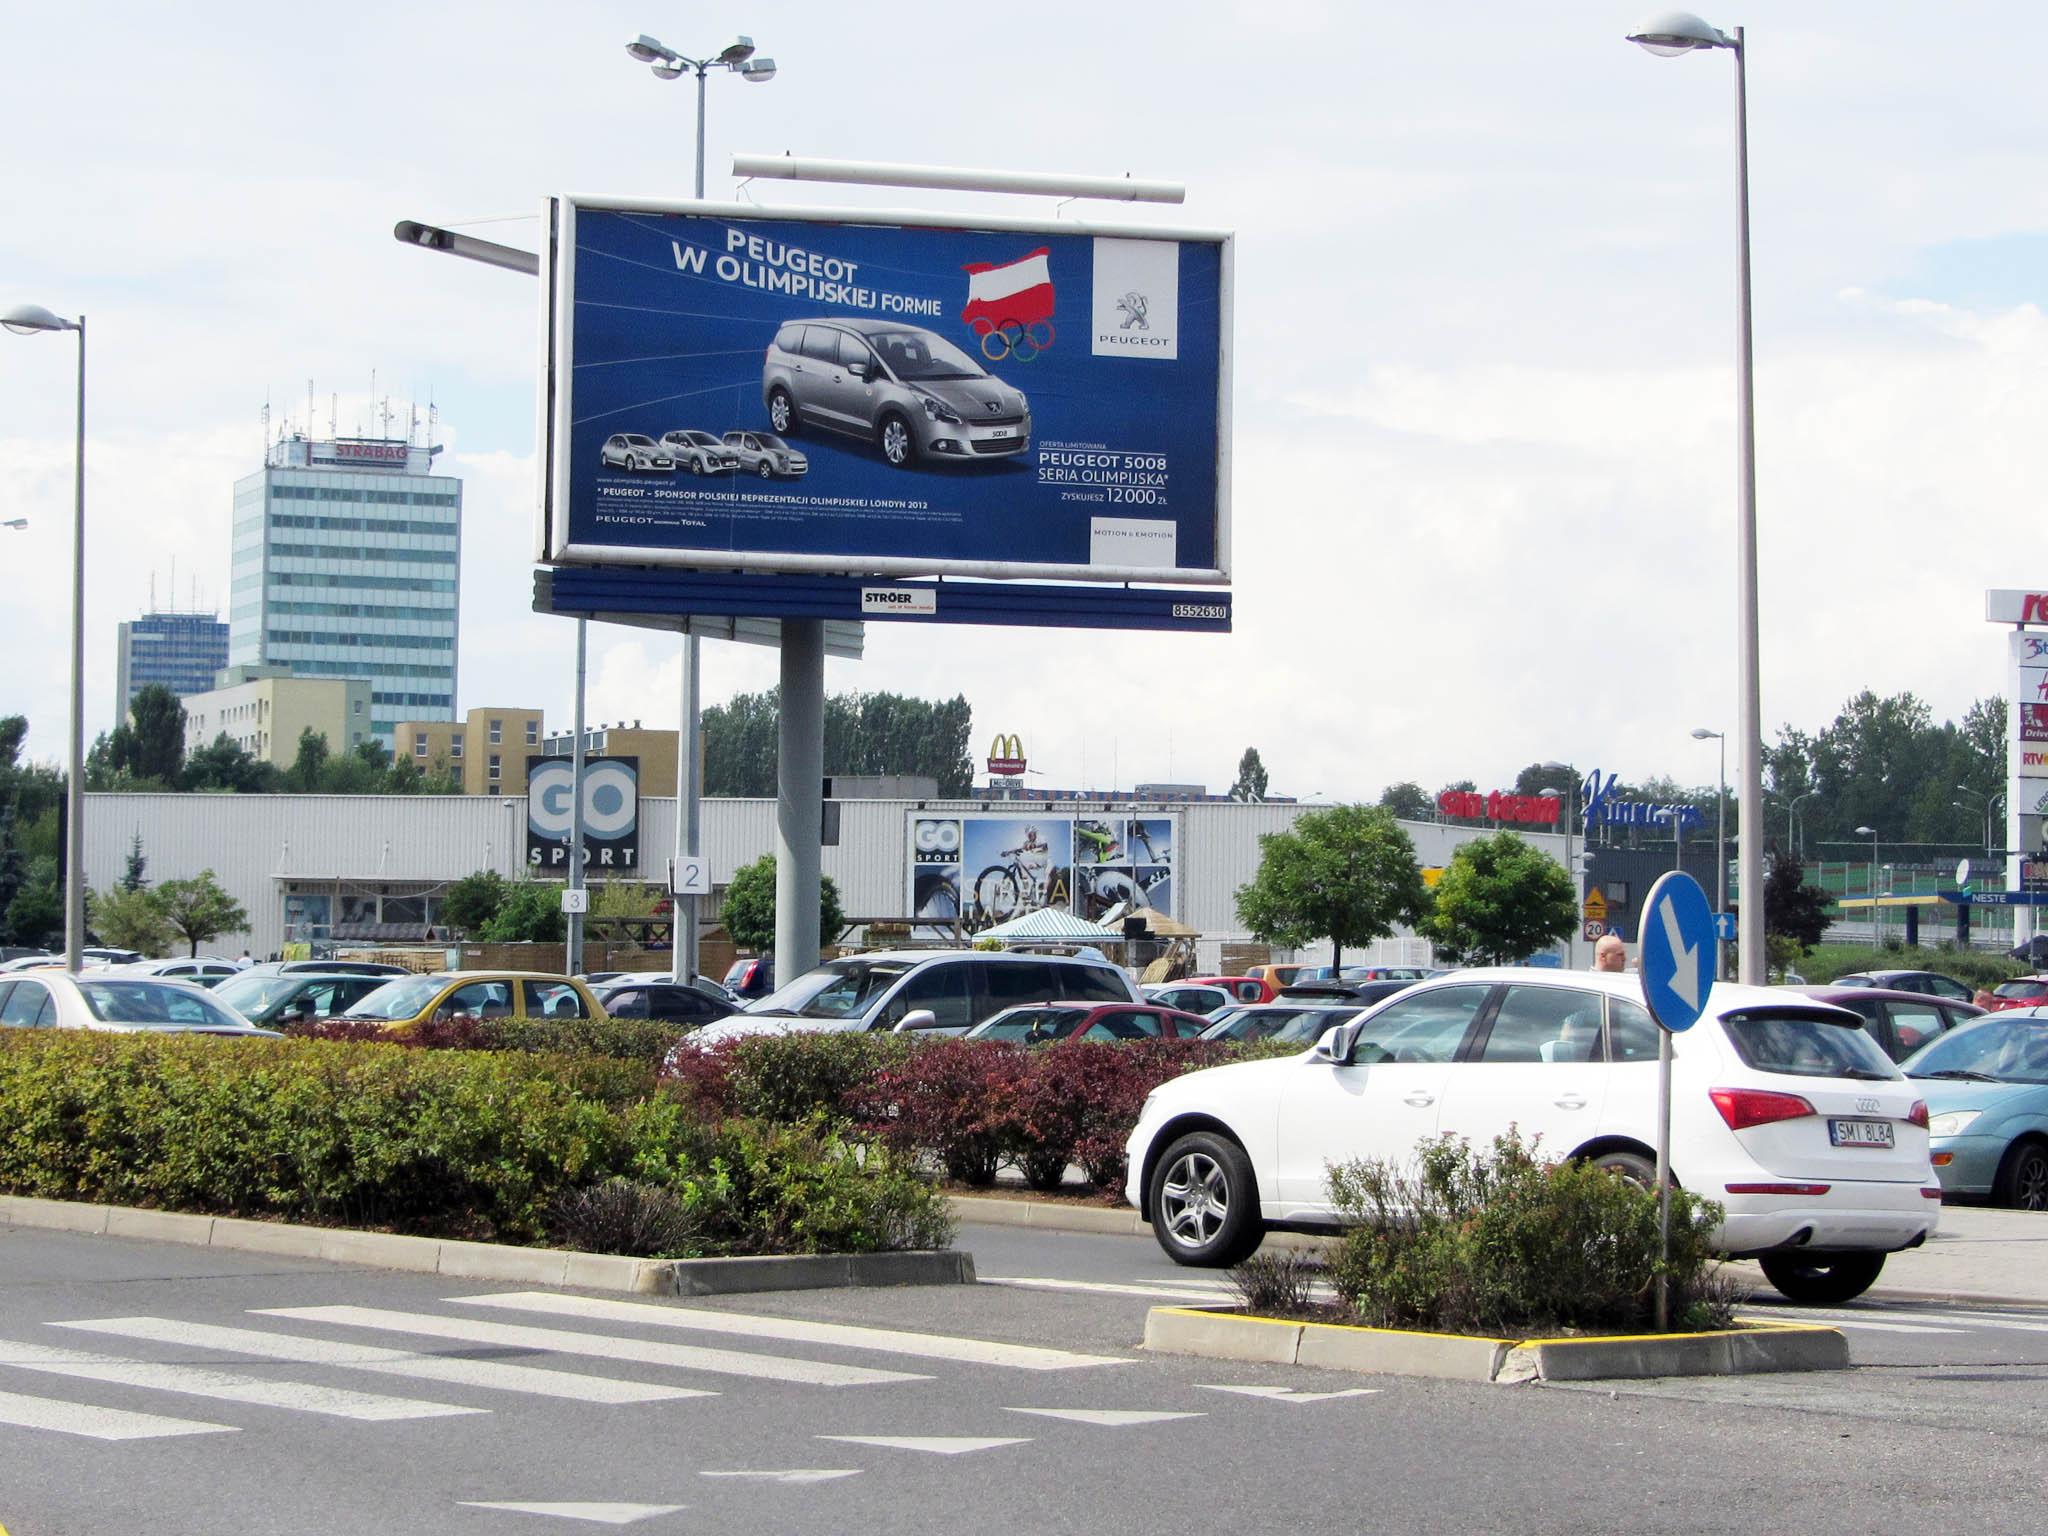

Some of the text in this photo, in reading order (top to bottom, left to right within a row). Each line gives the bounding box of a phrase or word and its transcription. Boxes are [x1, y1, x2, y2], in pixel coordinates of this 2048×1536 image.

[727, 228, 858, 283] PEUGEOT
[671, 241, 941, 316] W OLIMPIJSKIEJ FORMIE
[1099, 335, 1169, 346] PEUGEOT
[336, 445, 407, 458] STRABAG
[1064, 442, 1106, 450] LIMITOWANA
[1039, 452, 1167, 470] PEUGEOT 5008
[1038, 467, 1078, 481] SERIA
[603, 487, 645, 497] PEUGEOT
[654, 490, 696, 499] SPONSOR
[699, 492, 739, 501] POLSKIEJ
[741, 494, 808, 505] REPREZENTACJI
[810, 497, 868, 507] OLIMPIJSKIEJ
[870, 500, 906, 509] LONDYN
[907, 501, 928, 510] 2012
[1061, 492, 1104, 502] ZYSKUJESZ
[596, 515, 653, 524] PEUGEOT
[1094, 529, 1127, 537] MOTION
[1174, 605, 1225, 617] 8552630
[916, 821, 959, 850] GO
[917, 854, 957, 862] SPORT
[685, 864, 699, 887] 2
[570, 894, 580, 909] 3
[1972, 894, 2006, 903] NESTE
[1588, 924, 1602, 935] 20
[1838, 1123, 1861, 1140] SMI
